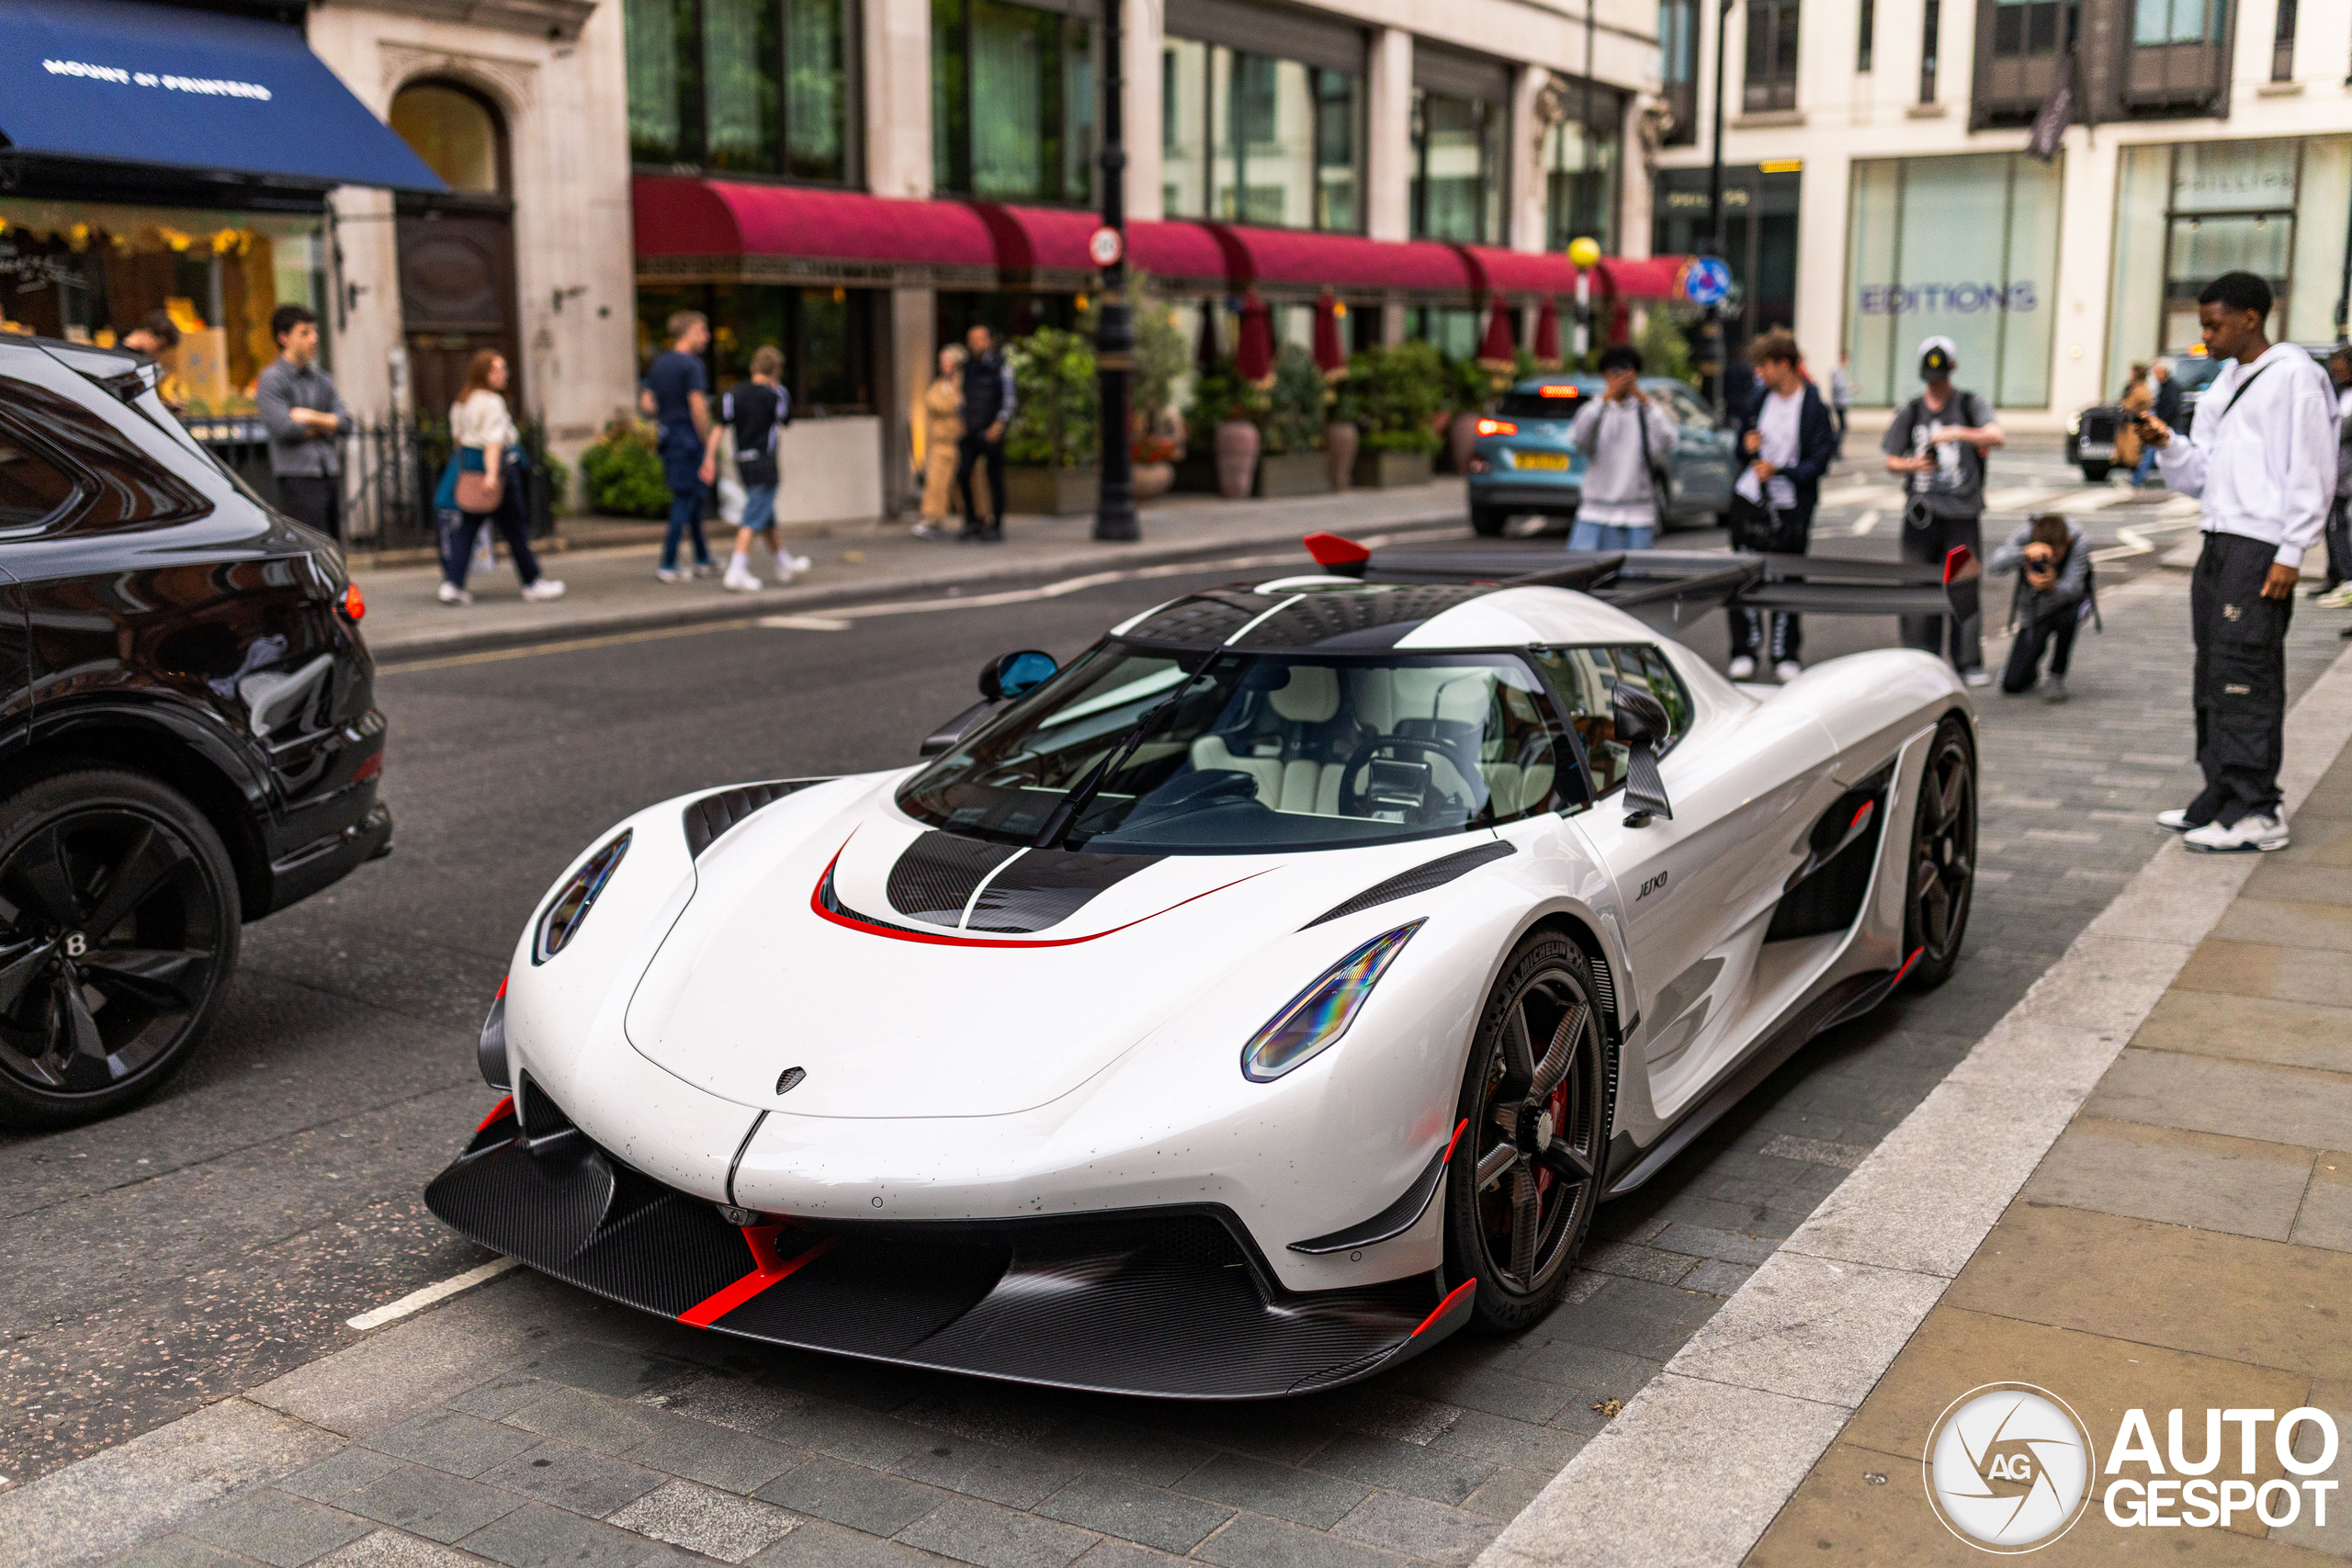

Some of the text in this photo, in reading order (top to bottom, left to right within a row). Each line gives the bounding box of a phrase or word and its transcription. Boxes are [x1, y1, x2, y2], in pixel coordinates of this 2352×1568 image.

[42, 59, 130, 85] MOUNT
[1860, 281, 2038, 315] EDITIONS
[1635, 870, 1668, 901] JESKO
[66, 934, 86, 956] B
[1520, 941, 1567, 976] MICHELIN
